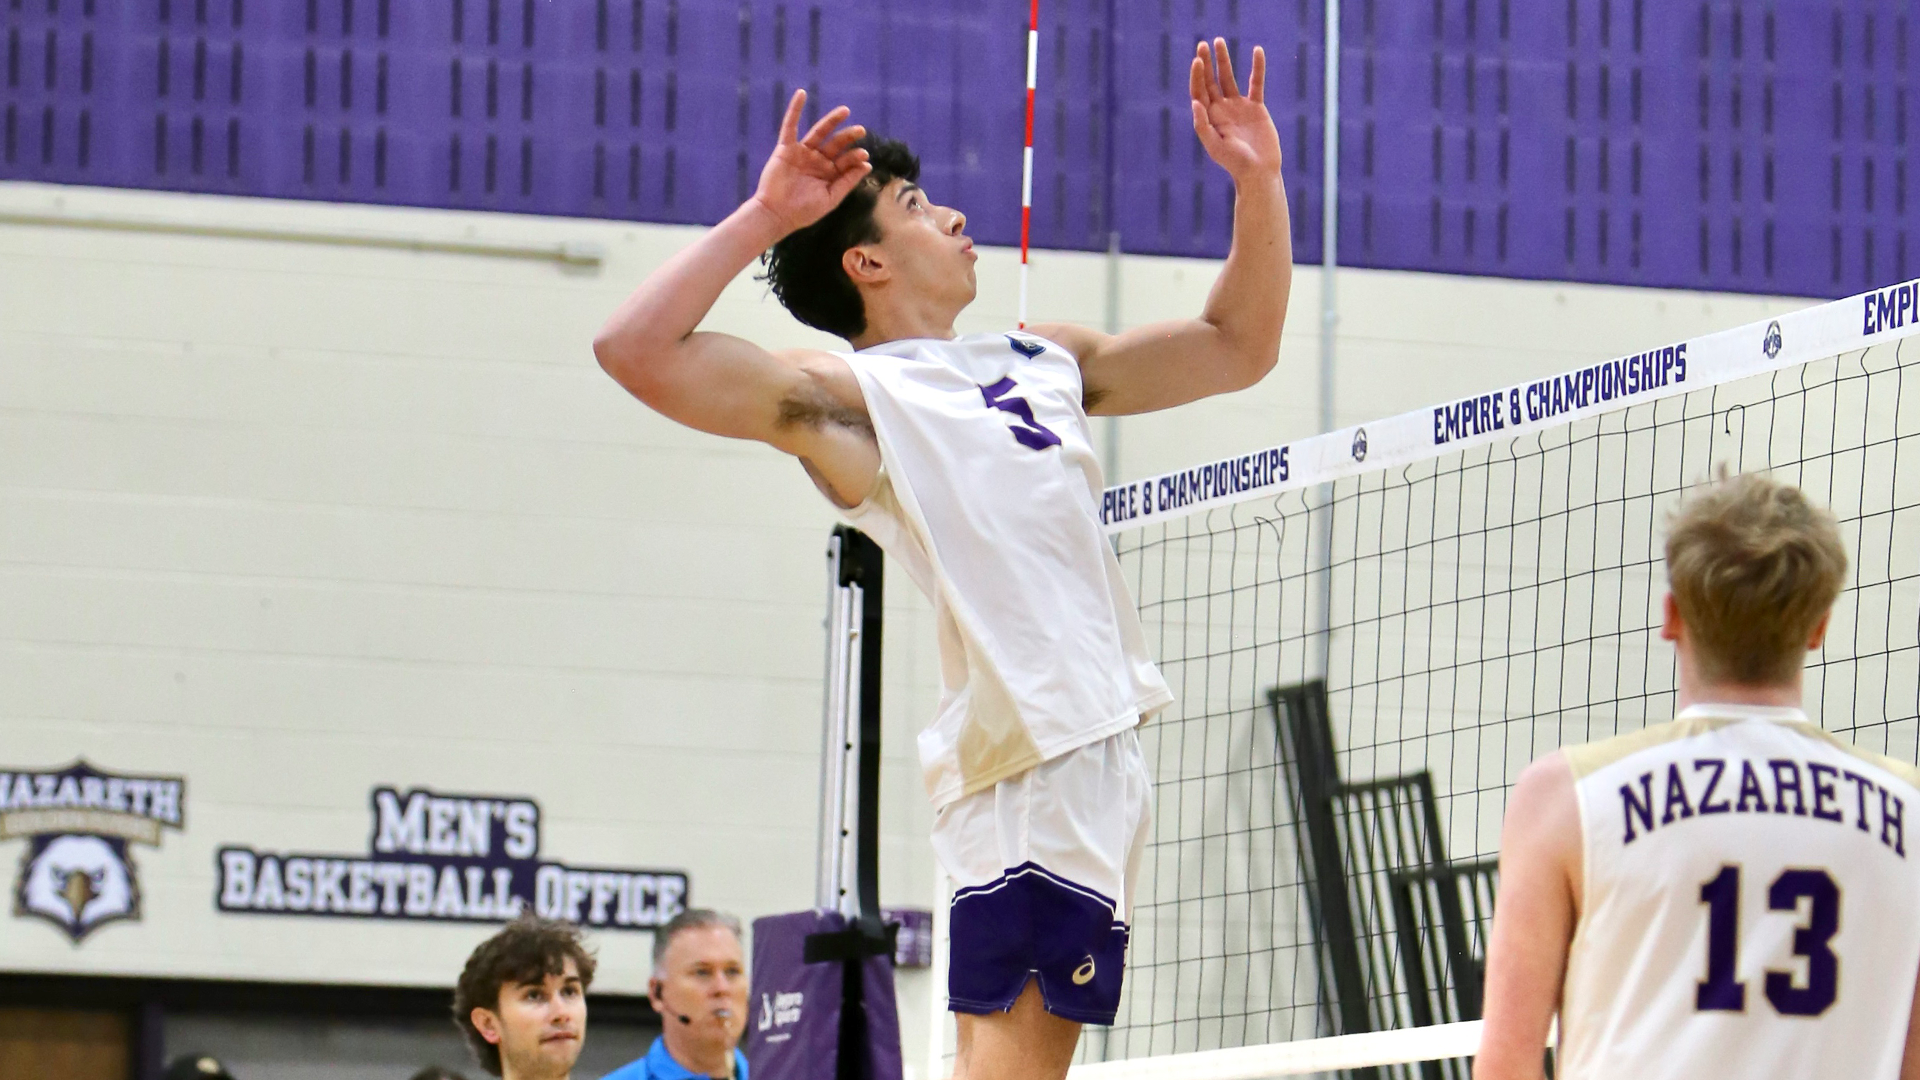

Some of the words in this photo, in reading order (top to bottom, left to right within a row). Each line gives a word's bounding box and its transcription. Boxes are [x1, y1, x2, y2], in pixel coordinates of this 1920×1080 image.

[1863, 282, 1920, 336] EMPI
[978, 376, 1062, 451] 5
[1434, 391, 1504, 445] EMPIRE
[1510, 387, 1522, 425] 8
[1526, 343, 1687, 422] CHAMPIONSHIPS
[1099, 484, 1137, 525] PIRE
[1142, 481, 1152, 515] 8
[1158, 446, 1290, 511] CHAMPIONSHIPS
[376, 790, 537, 859] MEN'S
[1618, 759, 1906, 860] NAZARETH
[221, 850, 524, 920] BASKETBALL
[535, 865, 685, 925] OFFICE
[1694, 863, 1842, 1018] 13
